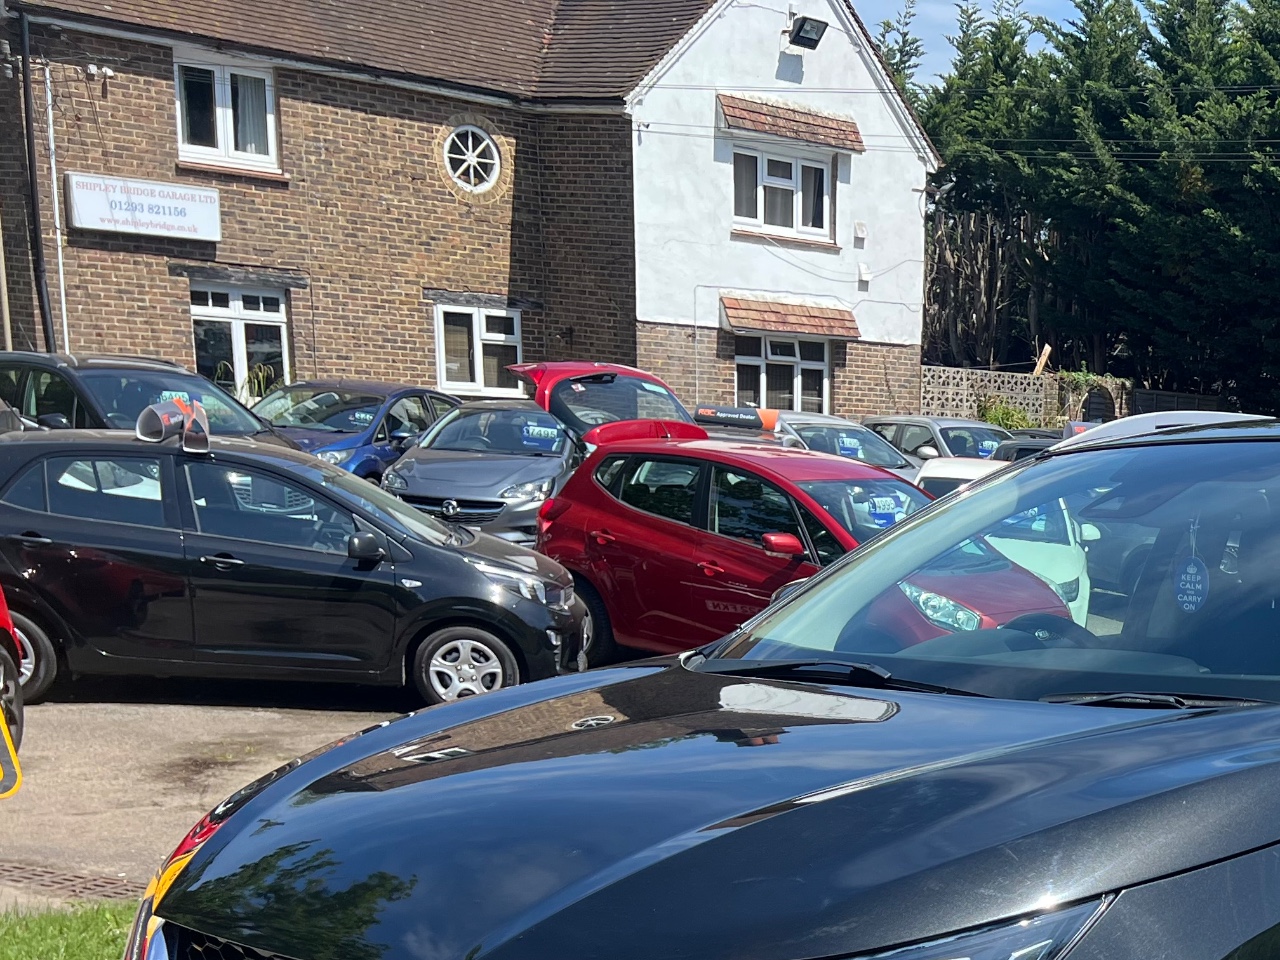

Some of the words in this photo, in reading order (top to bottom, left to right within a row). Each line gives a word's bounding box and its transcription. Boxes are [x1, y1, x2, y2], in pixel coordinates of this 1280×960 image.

[75, 181, 117, 193] SHIPLEY
[120, 185, 156, 197] BRIDGE
[159, 190, 196, 202] GARAGE
[199, 194, 216, 204] LTD
[110, 200, 144, 213] 01293
[148, 203, 186, 217] 821156
[99, 217, 198, 233] www.shipleybridge.co.uk
[716, 411, 739, 420] Approved
[1181, 574, 1202, 582] KEEP
[1180, 581, 1202, 590] CALM
[1177, 594, 1202, 603] CARRY
[1183, 603, 1196, 611] ON
